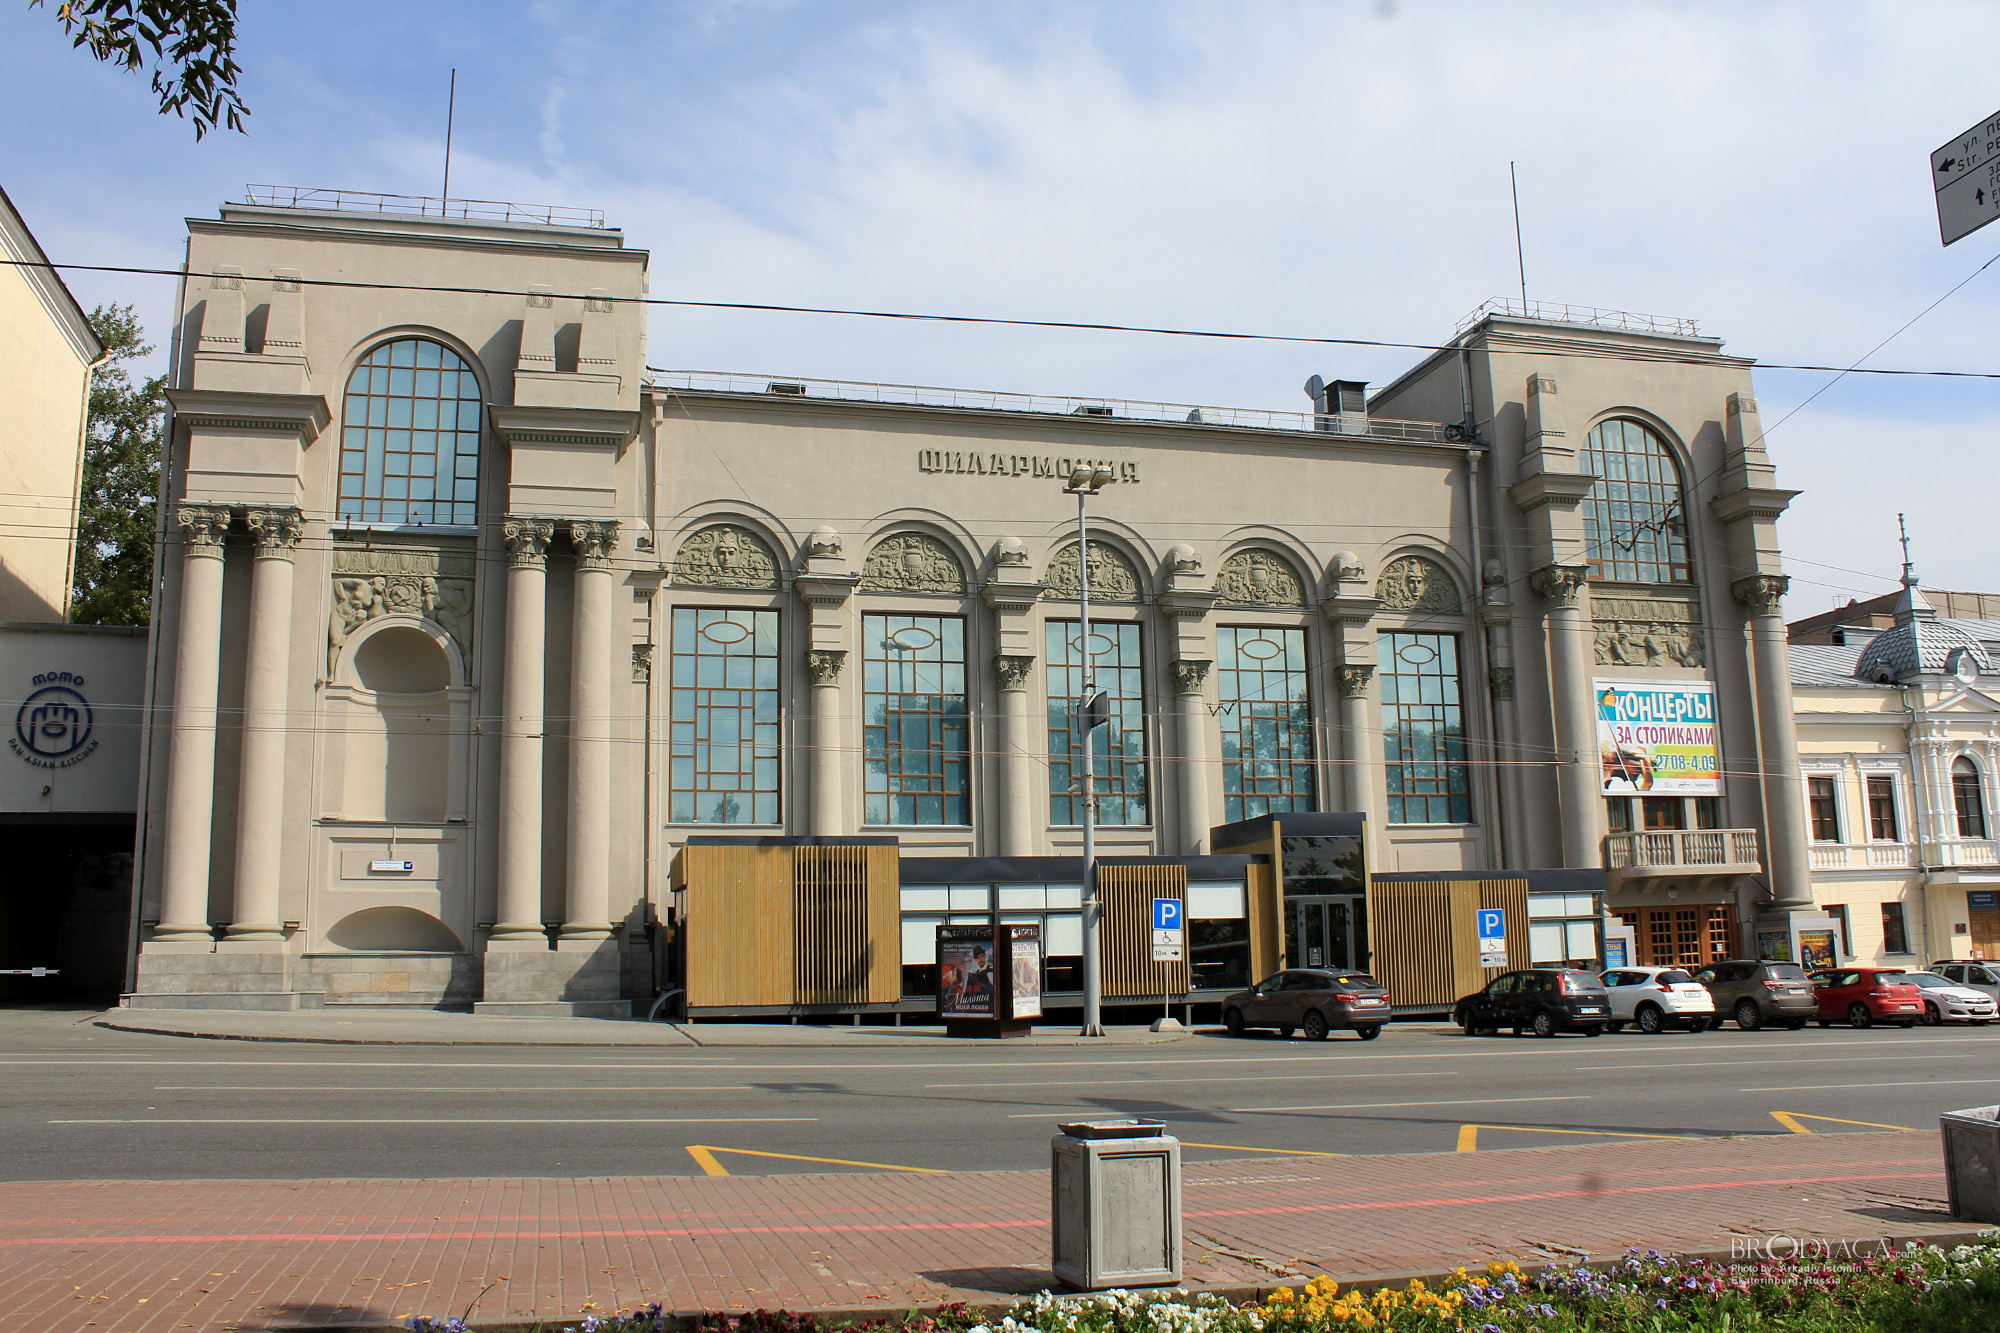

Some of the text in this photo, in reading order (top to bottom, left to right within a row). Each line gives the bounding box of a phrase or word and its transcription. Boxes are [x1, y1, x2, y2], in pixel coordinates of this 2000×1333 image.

[1963, 135, 1982, 153] ул.
[1957, 153, 1982, 172] Str.
[1615, 691, 1713, 723] КОНЦЕРТЫ
[1616, 726, 1714, 745] ЗА СТОЛИКАМИ
[8, 738, 99, 769] PAN ASIAN KITCHEN
[1655, 754, 1717, 771] 27.08-4.09
[1161, 903, 1177, 926] P
[1485, 913, 1500, 935] P
